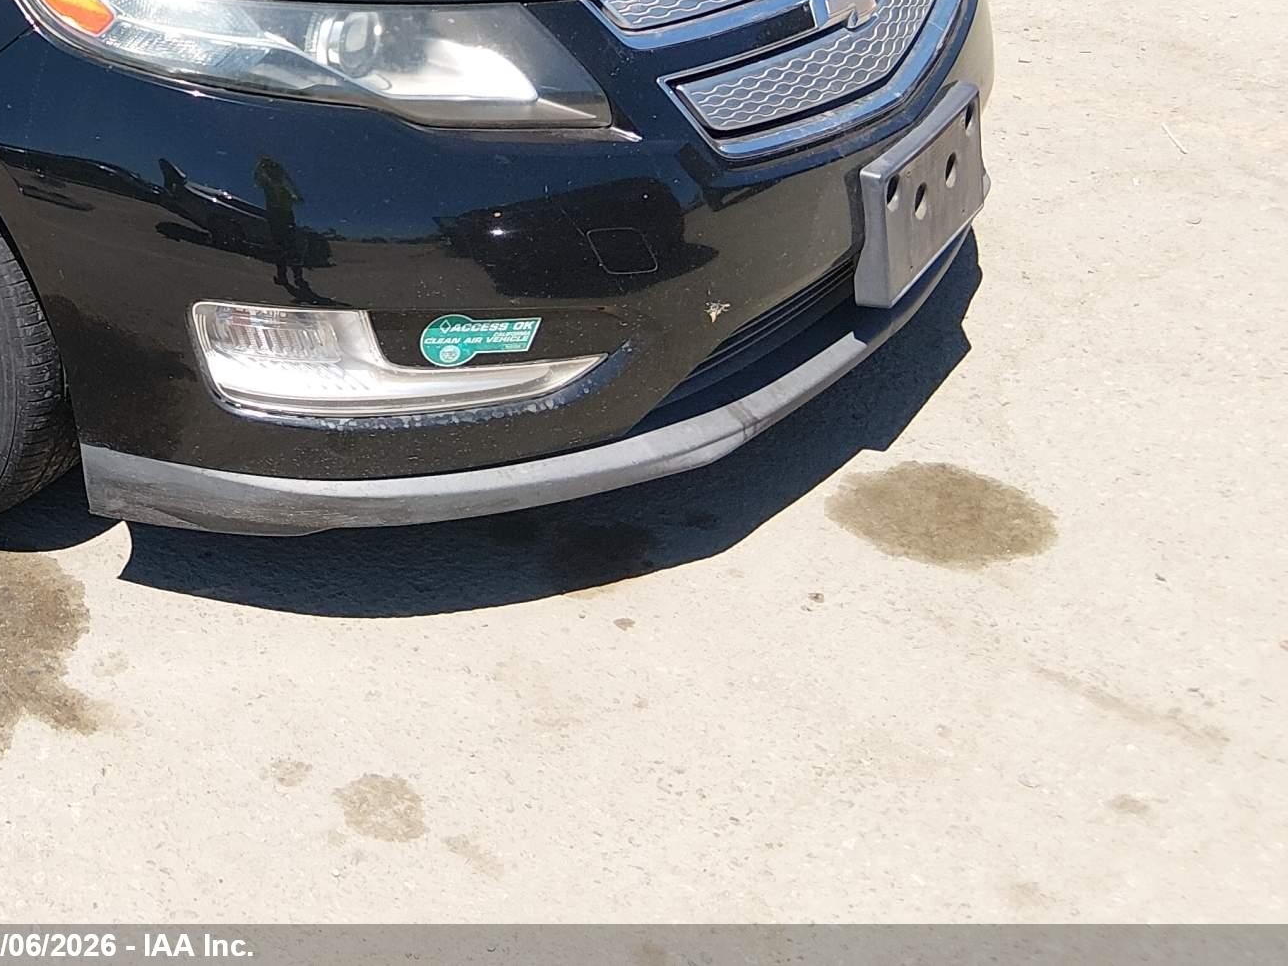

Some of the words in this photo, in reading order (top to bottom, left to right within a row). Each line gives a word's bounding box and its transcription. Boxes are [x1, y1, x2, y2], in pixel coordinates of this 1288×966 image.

[450, 322, 508, 333] ACCESS
[513, 321, 533, 331] OK
[424, 337, 460, 345] CLEAN
[486, 335, 529, 343] VEHICLE
